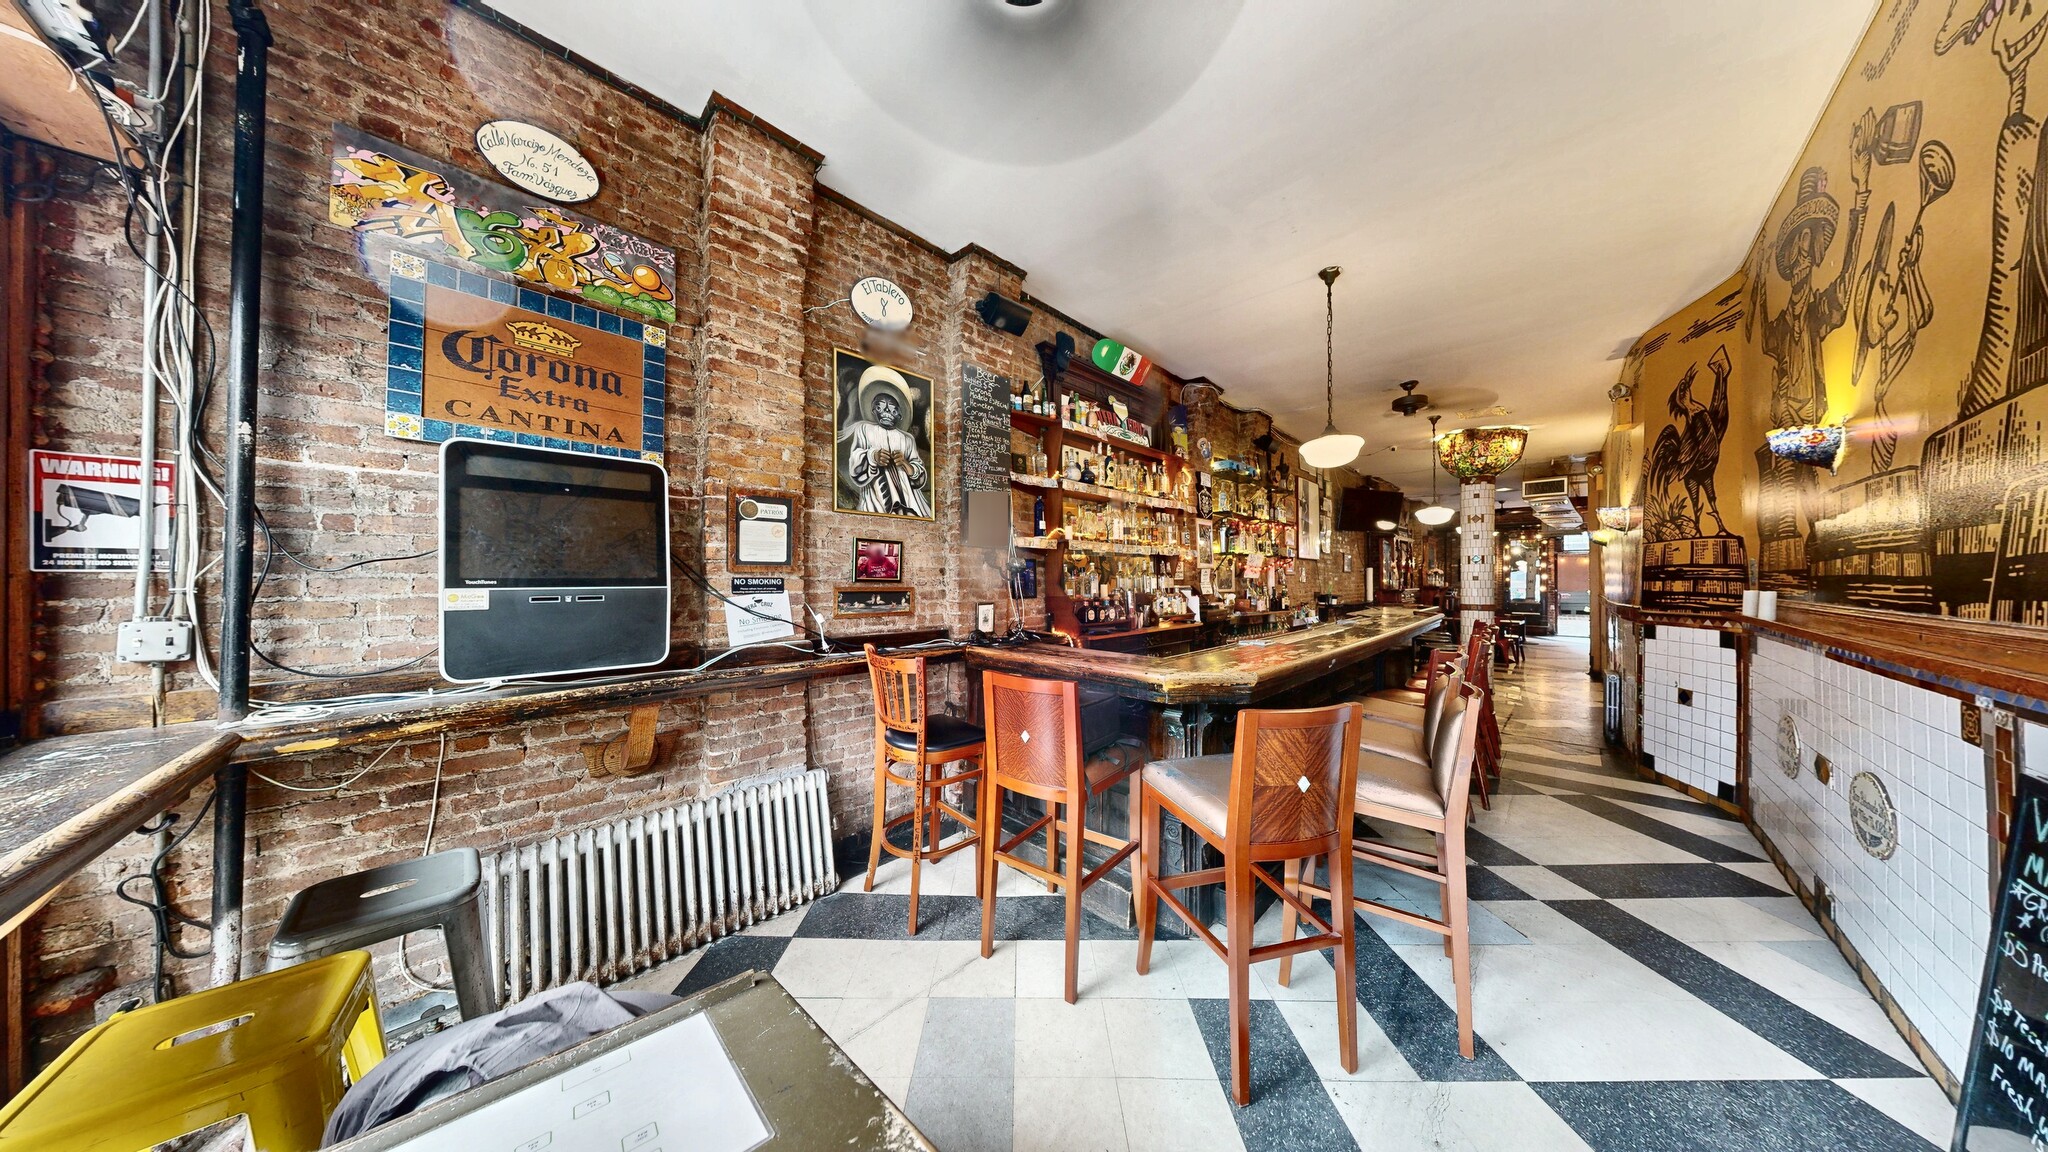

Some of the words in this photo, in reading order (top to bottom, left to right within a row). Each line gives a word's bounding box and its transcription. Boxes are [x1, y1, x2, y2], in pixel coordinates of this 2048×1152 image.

[480, 129, 504, 151] Calle
[544, 143, 596, 182] Mendoza
[521, 153, 537, 169] No.
[542, 163, 558, 176] 51
[861, 281, 872, 295] El
[869, 280, 905, 305] Tablero
[442, 330, 623, 397] Corona
[976, 366, 999, 383] Beer
[499, 375, 589, 413] Extra
[445, 400, 625, 443] CANTINA
[1990, 1063, 2034, 1124] Fresh
[2017, 1056, 2048, 1098] MA
